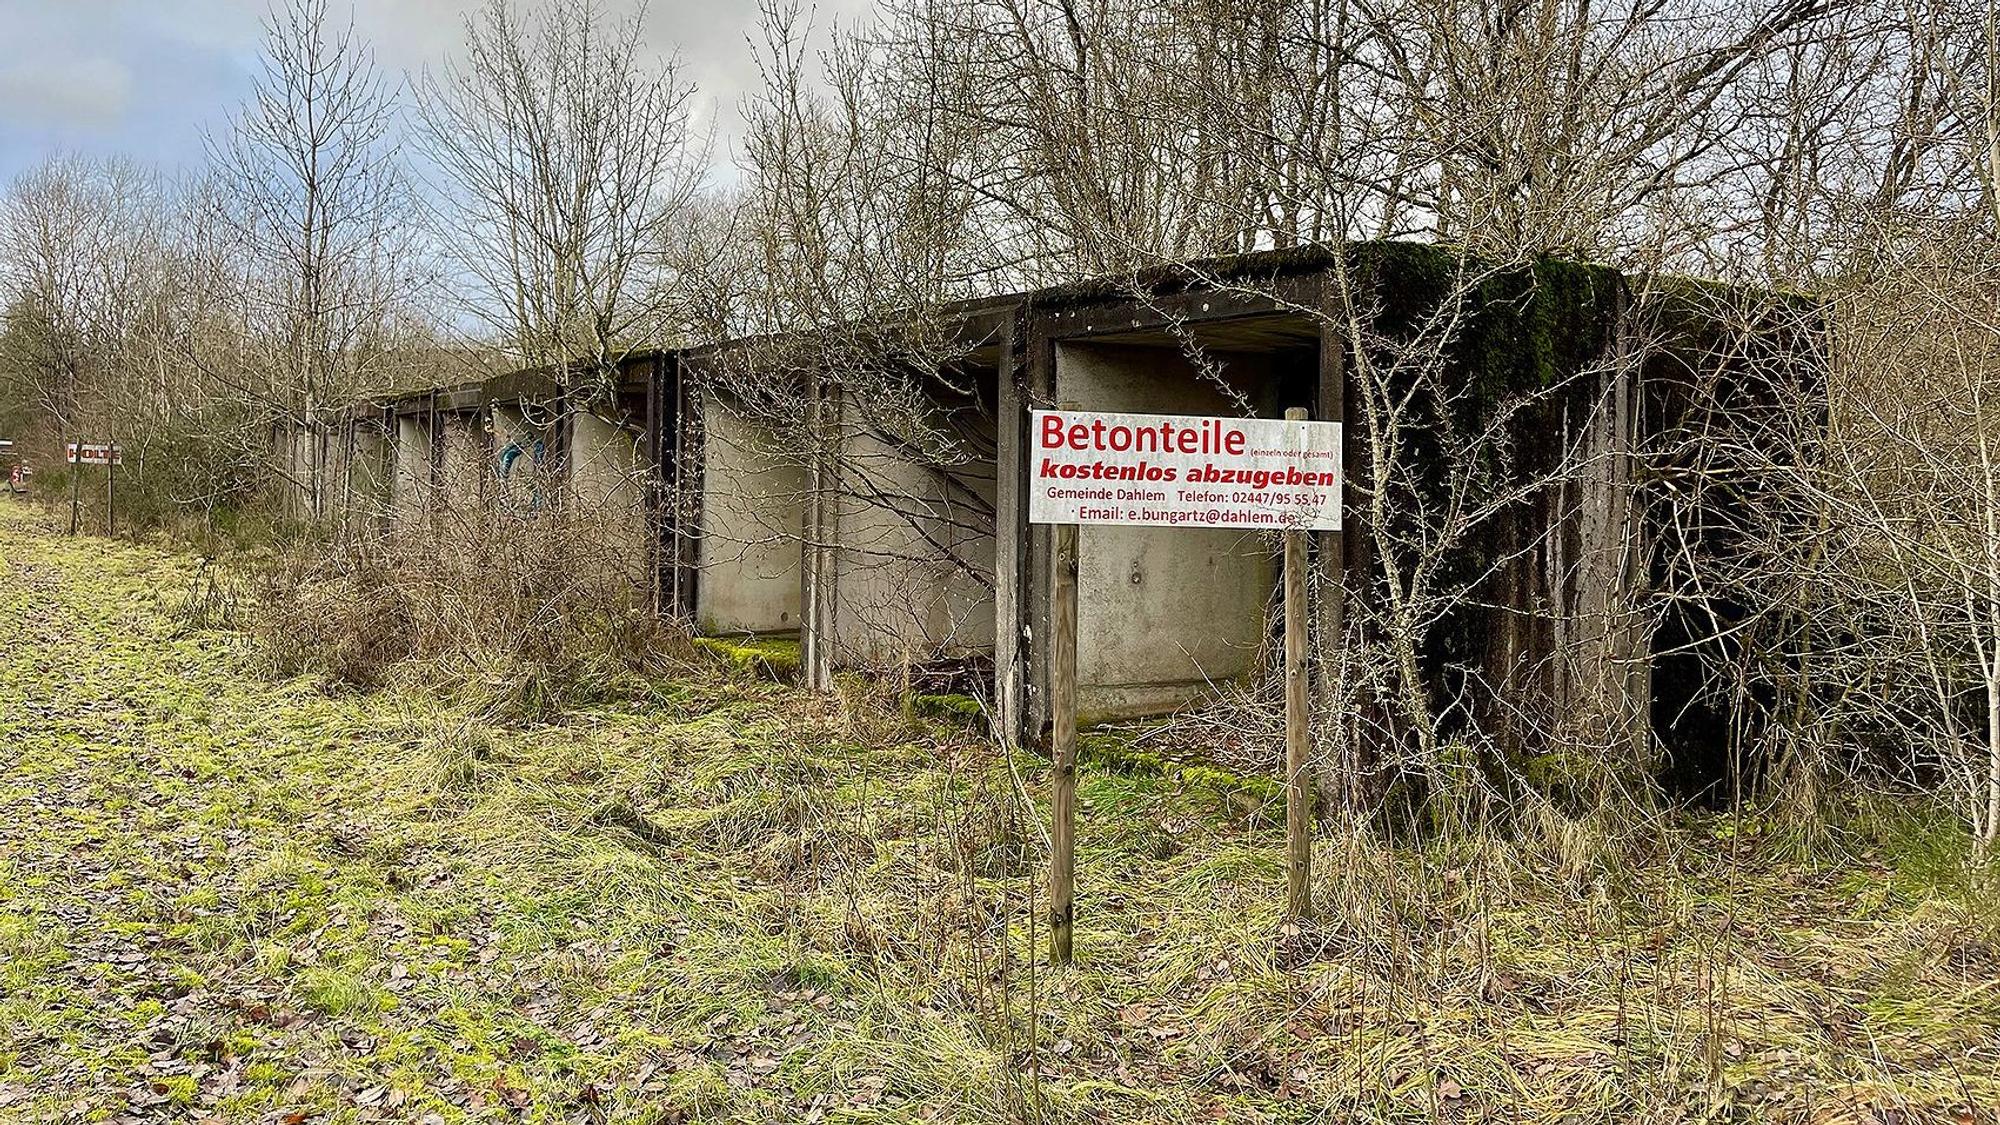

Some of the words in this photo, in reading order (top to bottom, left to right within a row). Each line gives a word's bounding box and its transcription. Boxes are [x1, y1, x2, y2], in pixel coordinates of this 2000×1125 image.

[1042, 415, 1245, 455] Betonteile
[1250, 448, 1281, 457] (einzeln
[1283, 449, 1301, 458] oder
[1040, 458, 1177, 481] kostenlos
[1186, 463, 1334, 489] abzugeben
[1047, 487, 1113, 500] Gemeinde
[1117, 489, 1165, 501] Dahlem
[1177, 490, 1228, 503] Telefon:
[1232, 492, 1291, 506] 02447/95
[1080, 507, 1123, 520] Email:
[1128, 507, 1296, 525] e.bungartz@dahlem.de
